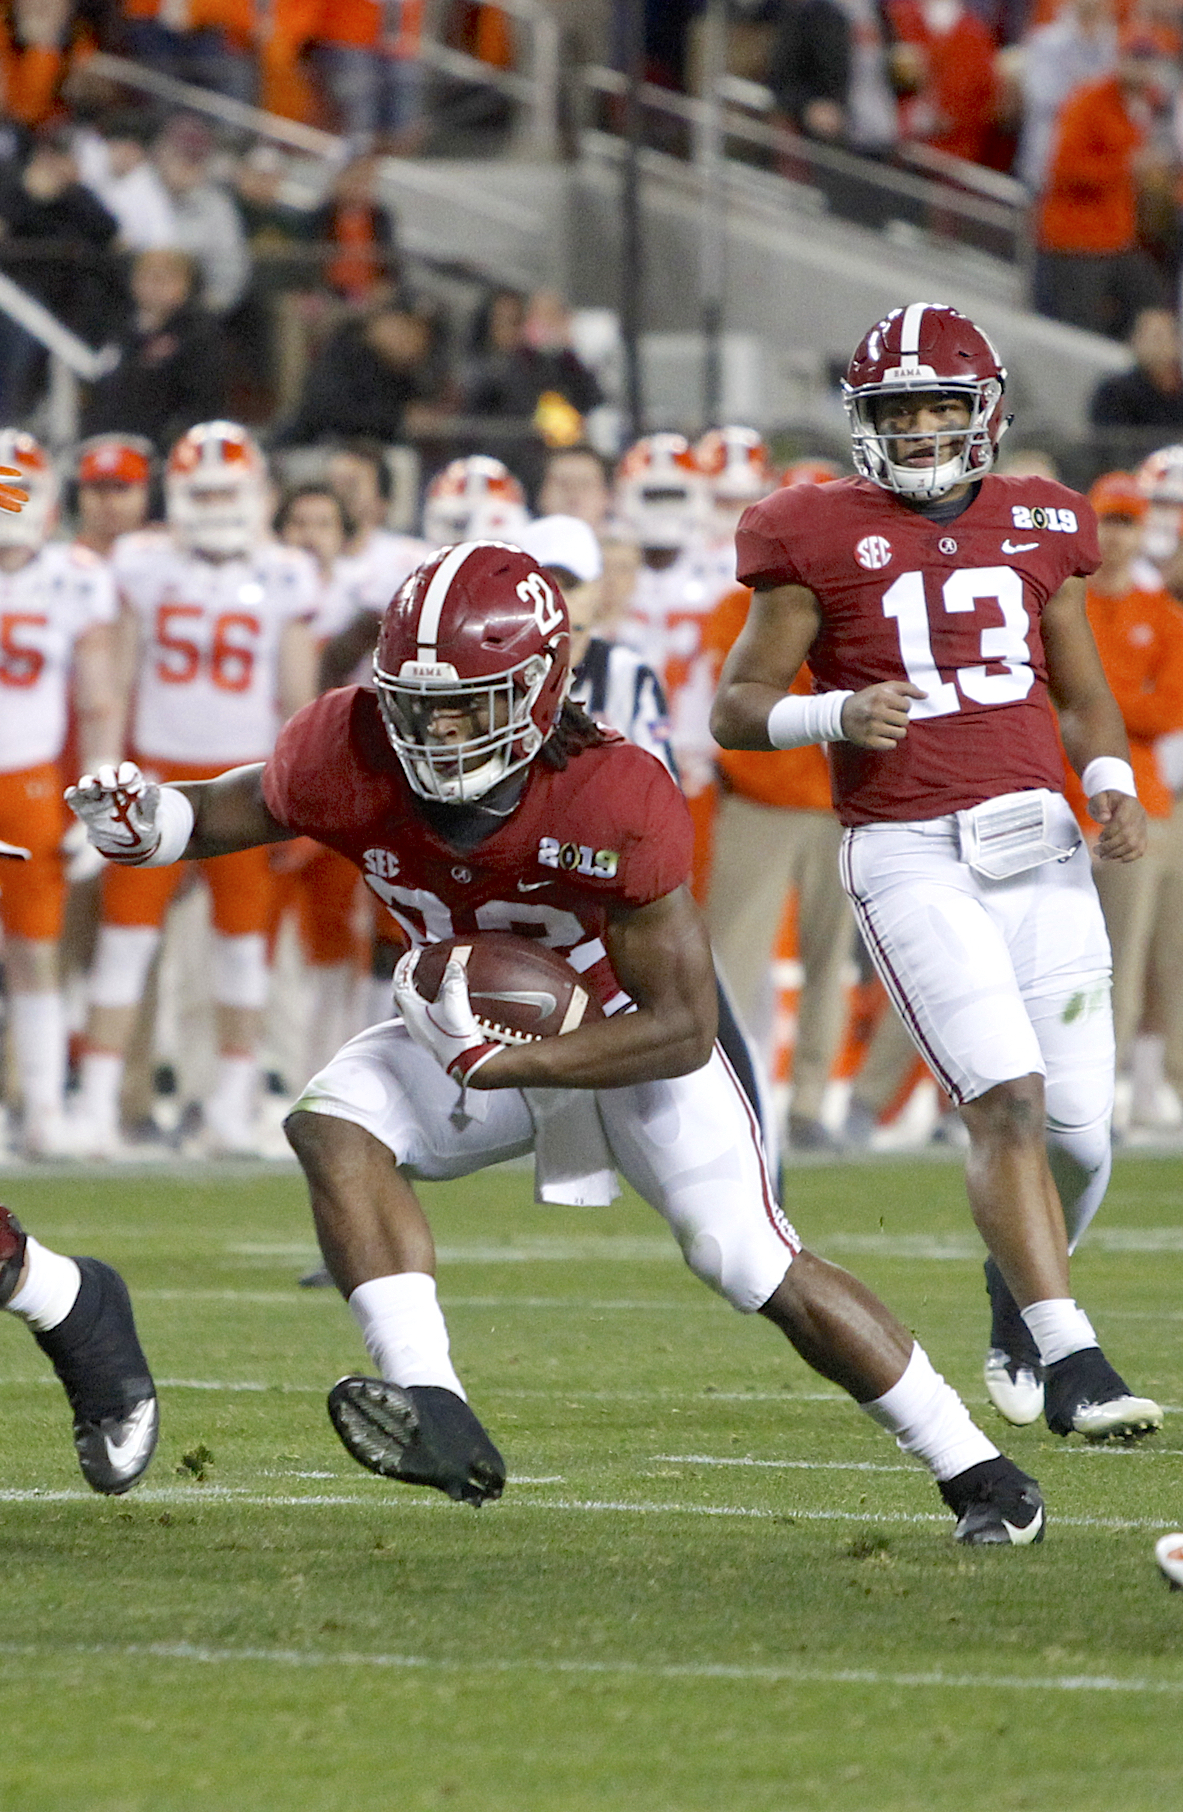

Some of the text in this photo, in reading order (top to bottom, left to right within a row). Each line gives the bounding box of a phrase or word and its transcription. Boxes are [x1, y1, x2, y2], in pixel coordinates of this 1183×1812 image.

[894, 368, 921, 378] BAMA
[1011, 505, 1078, 533] 2019
[857, 535, 893, 569] SEC
[515, 572, 564, 637] 22
[156, 605, 260, 692] 56
[882, 565, 1035, 720] 13
[413, 667, 442, 677] BAMA
[363, 848, 401, 879] SEC
[538, 836, 618, 879] 2019
